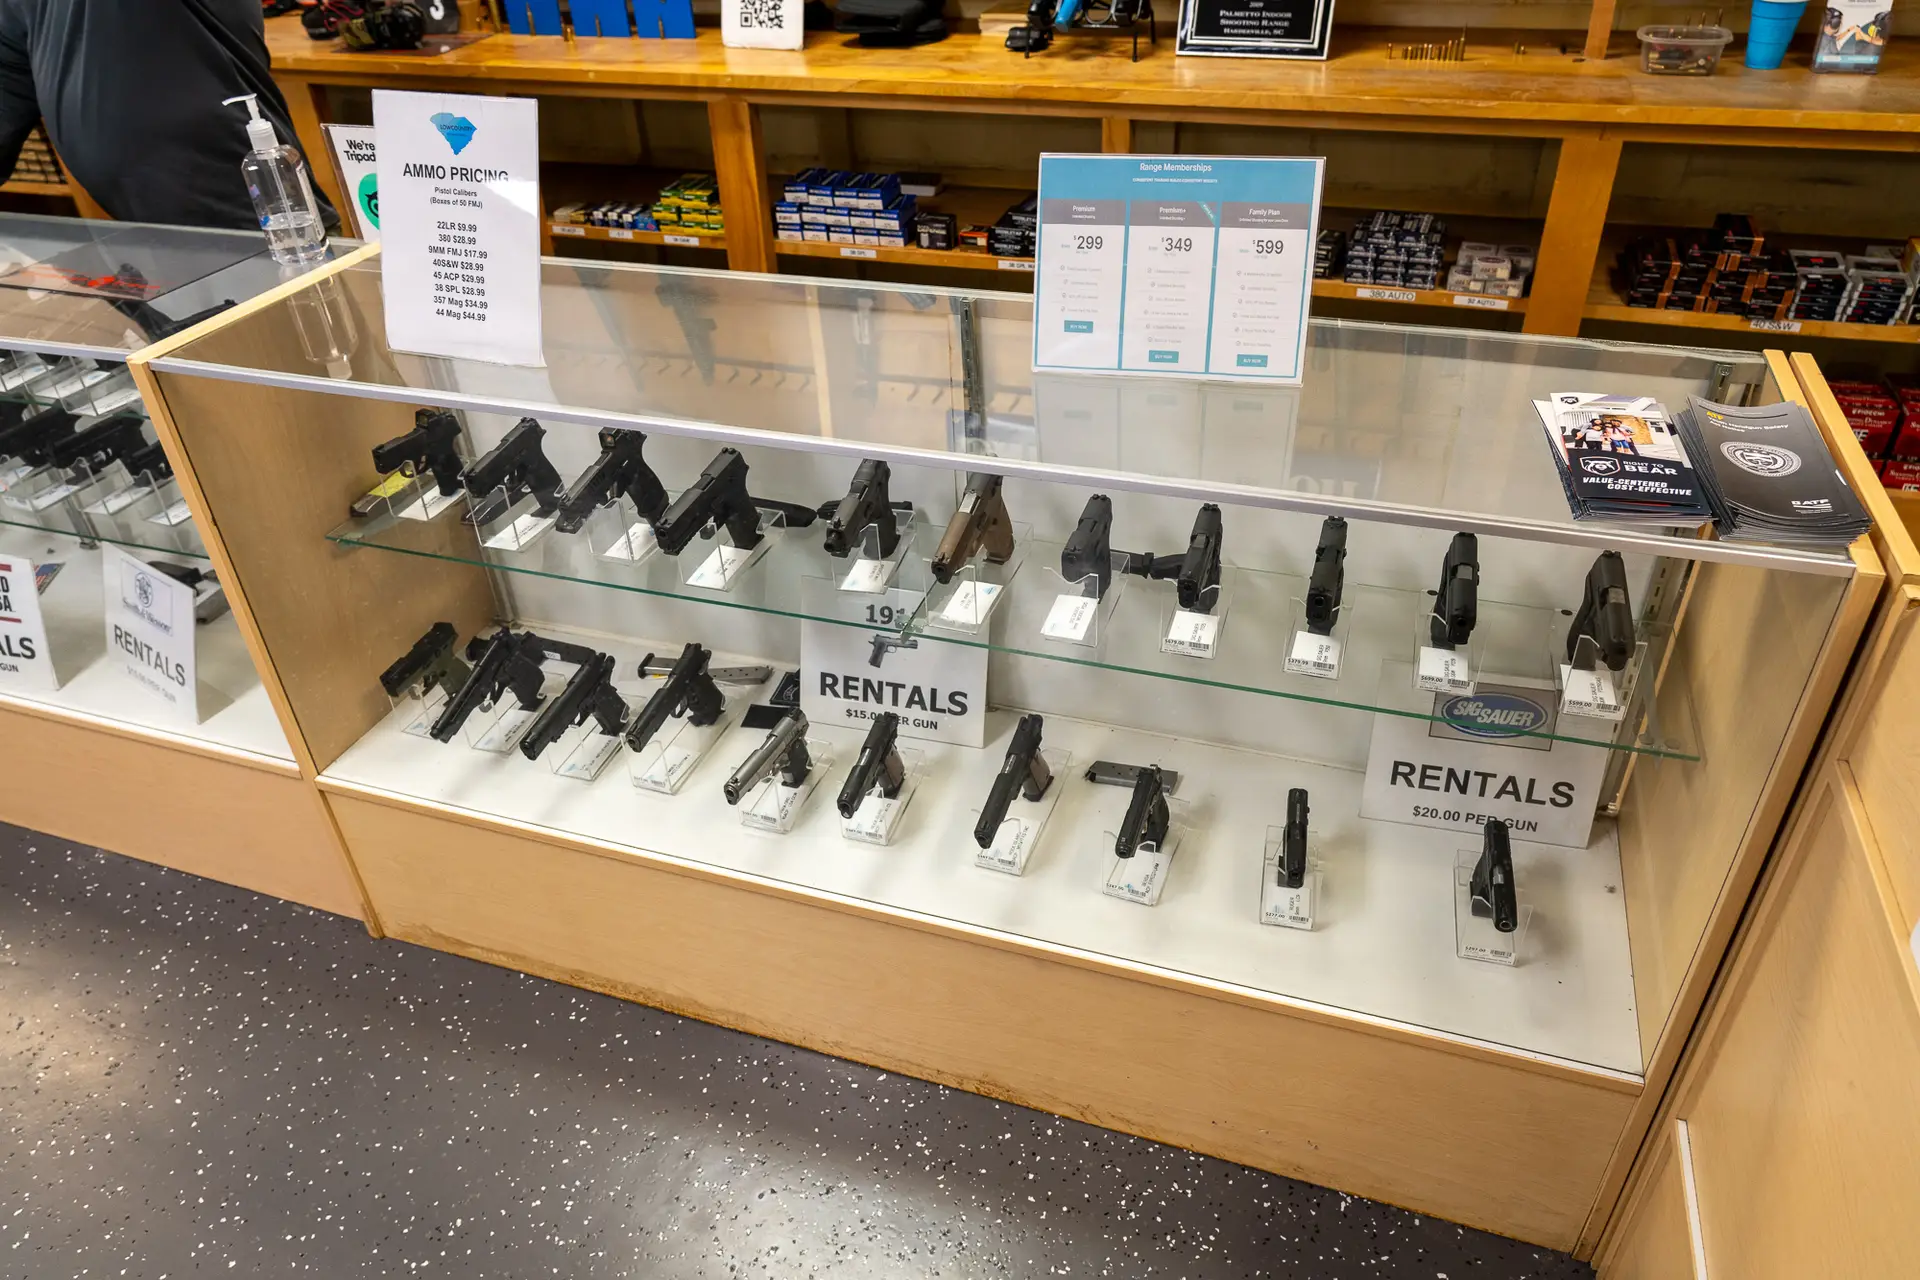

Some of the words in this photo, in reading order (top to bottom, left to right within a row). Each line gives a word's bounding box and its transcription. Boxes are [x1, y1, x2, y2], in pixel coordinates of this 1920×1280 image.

[1219, 10, 1261, 18] PALMETTO
[1262, 10, 1292, 18] INDOOR
[1261, 19, 1290, 27] RANGE
[346, 139, 375, 151] We're
[403, 162, 446, 179] AMMO
[450, 166, 509, 183] PRICING
[1140, 162, 1162, 172] Range
[1163, 163, 1212, 173] Memberships
[434, 186, 452, 195] Pistol
[453, 188, 478, 197] Calibers
[429, 197, 450, 205] (Boxes
[459, 199, 467, 207] 50
[468, 200, 483, 209] FMJ)
[1249, 209, 1267, 217] Family
[437, 221, 456, 230] 22LR
[457, 222, 477, 233] $9.99
[438, 233, 451, 242] 380
[453, 235, 476, 245] $28.99
[428, 245, 445, 254] 9MM
[447, 247, 462, 257] FMJ
[464, 249, 488, 259] $17.99
[433, 258, 459, 268] 40S&W
[460, 261, 484, 271] $28.99
[433, 271, 442, 279] 45
[443, 272, 460, 281] ACP
[461, 274, 485, 284] $29.99
[435, 283, 444, 292] 38
[445, 284, 460, 293] SPL
[462, 286, 485, 297] $28.99
[1369, 290, 1385, 298] 380
[1387, 292, 1414, 300] AUTO
[433, 295, 446, 304] 357
[448, 297, 463, 308] Mag
[465, 299, 488, 309] $34.99
[436, 308, 444, 316] 44
[446, 309, 461, 320] Mag
[463, 311, 486, 322] $44.99
[1752, 320, 1765, 328] 40
[1767, 320, 1793, 330] S&W
[1706, 411, 1724, 420] ATF
[1624, 465, 1678, 475] BEAR
[1582, 477, 1668, 488] VALUE-CENTERED
[1607, 483, 1693, 496] COST-EFFECTIVE
[0, 576, 10, 593] D
[114, 624, 186, 687] RENTALS
[1421, 675, 1443, 683] $699.00
[819, 671, 968, 717] RENTALS
[1568, 700, 1592, 708] $599.00
[1453, 700, 1485, 718] SIG
[1478, 708, 1535, 728] SAUER
[913, 718, 938, 730] GUN
[1390, 760, 1576, 808] RENTALS
[1412, 805, 1461, 822] $20.00
[1505, 817, 1538, 832] GUN
